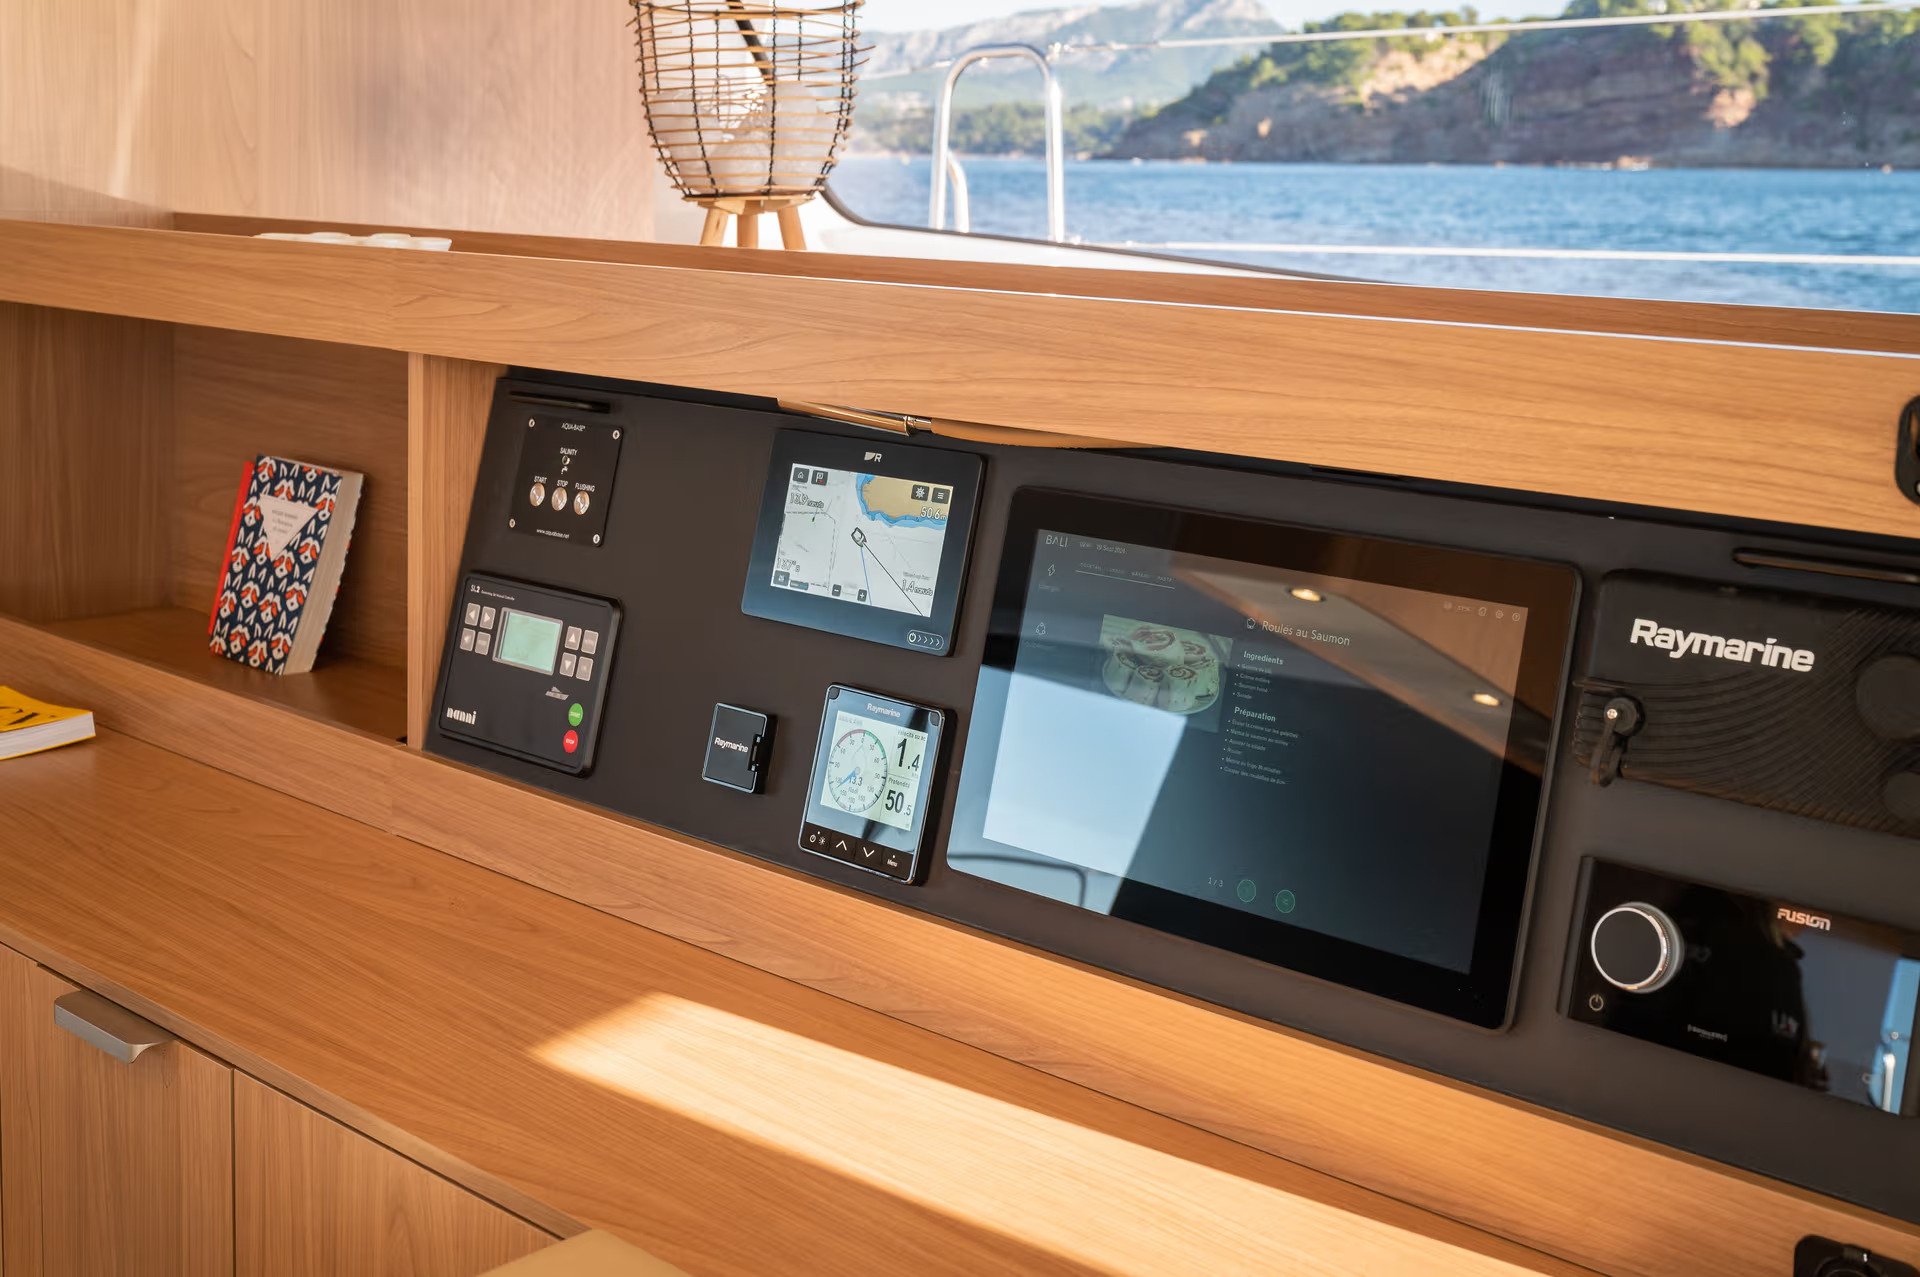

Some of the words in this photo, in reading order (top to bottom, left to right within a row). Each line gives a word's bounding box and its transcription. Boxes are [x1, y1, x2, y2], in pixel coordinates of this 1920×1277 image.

[560, 447, 578, 456] SALINITY
[534, 476, 547, 484] START
[557, 479, 568, 487] STOP
[575, 482, 595, 493] FLUSHING
[1045, 534, 1069, 548] BALI
[1295, 628, 1308, 638] au
[1311, 629, 1351, 646] Saumon
[1629, 618, 1815, 673] Raymarine
[1243, 651, 1284, 666] Ingredients
[446, 707, 477, 724] nanni
[867, 702, 901, 719] Raymarine
[1234, 706, 1276, 722] Préparation
[714, 737, 749, 753] Raymarine
[897, 738, 920, 771] 1.4
[885, 789, 912, 816] 50.5
[887, 859, 898, 867] Menu
